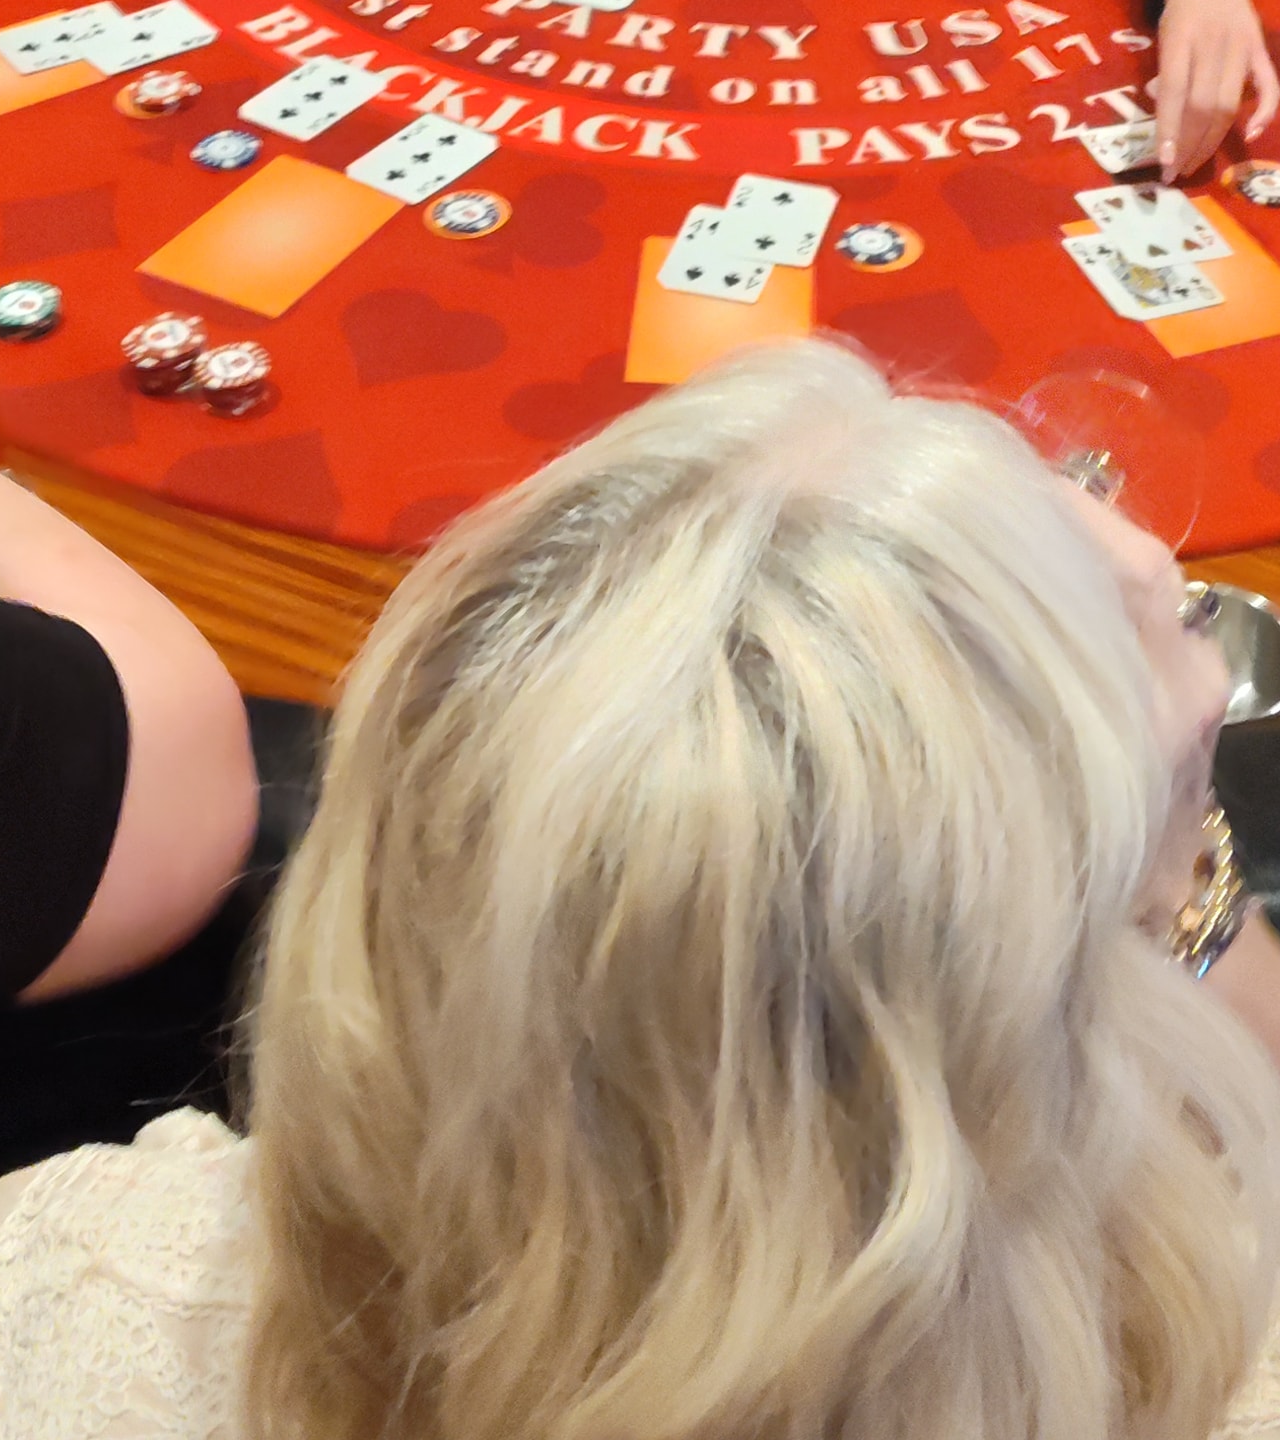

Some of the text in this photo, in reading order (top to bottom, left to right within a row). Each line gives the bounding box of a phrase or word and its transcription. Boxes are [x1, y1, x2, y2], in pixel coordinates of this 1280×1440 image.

[431, 25, 676, 100] stand
[708, 76, 820, 106] on
[856, 58, 991, 105] all
[791, 112, 1022, 168] PAYS
[1027, 102, 1088, 143] 2
